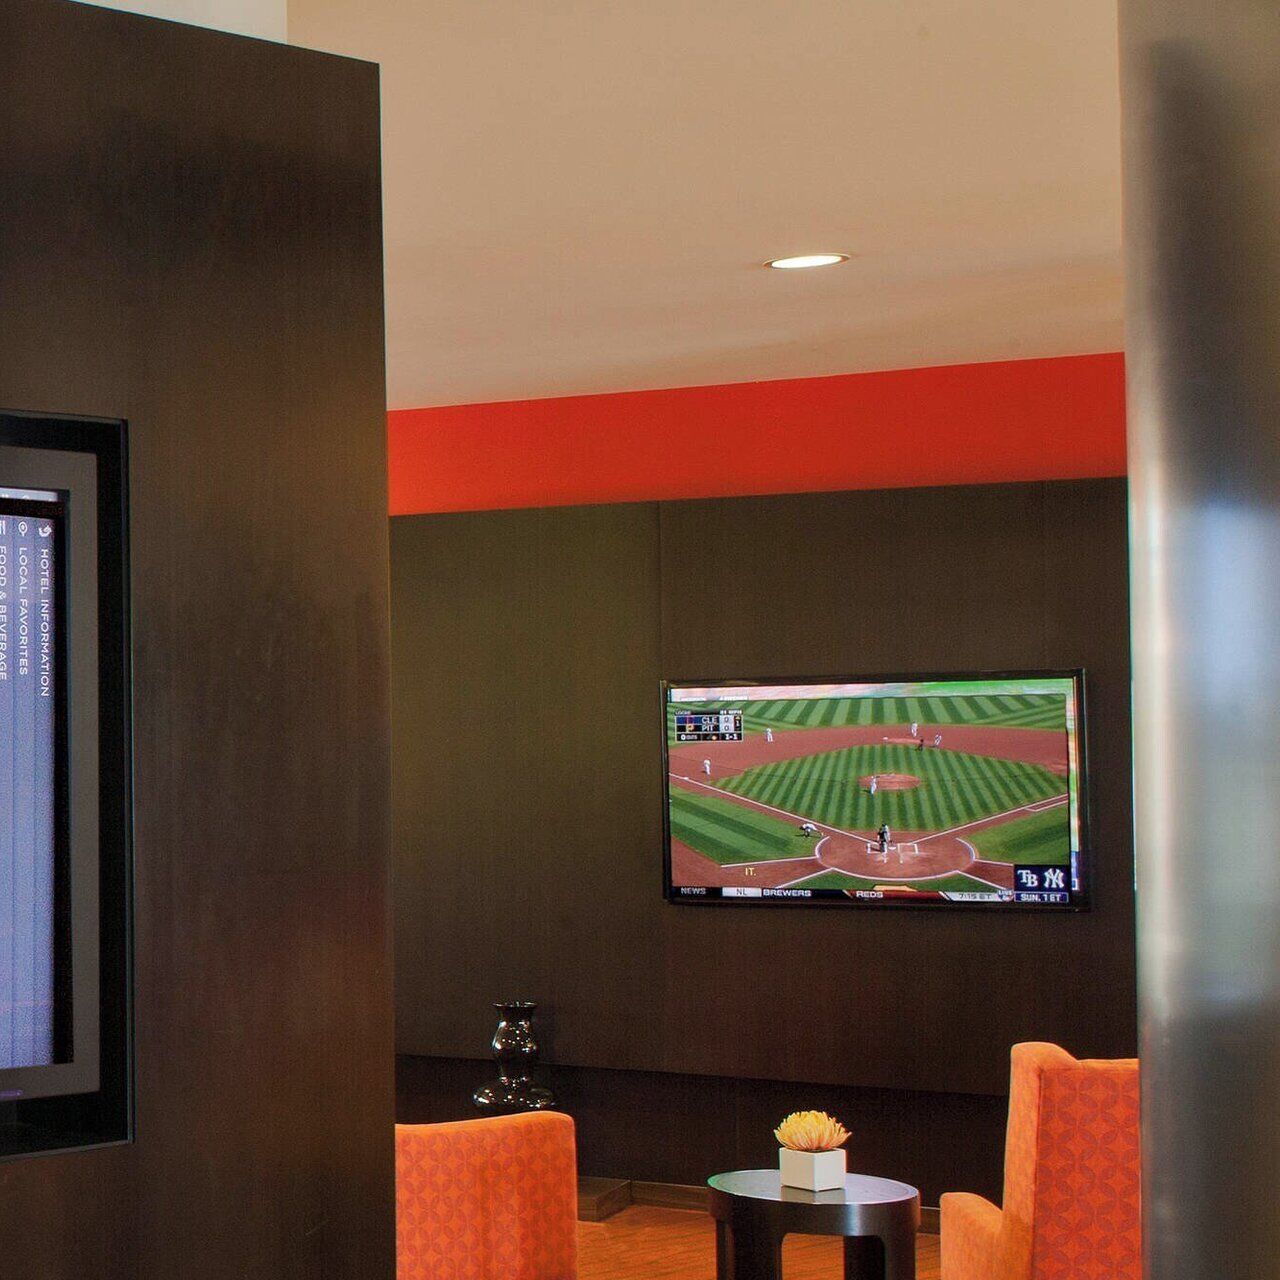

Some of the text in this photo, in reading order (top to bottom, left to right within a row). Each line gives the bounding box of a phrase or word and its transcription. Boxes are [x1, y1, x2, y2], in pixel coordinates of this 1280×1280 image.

[0, 591, 7, 600] &
[19, 548, 28, 675] LOCAL FAVORITES
[40, 549, 49, 697] HOTEL INFORMATION
[745, 868, 756, 876] IT.
[763, 889, 811, 897] BREWERS
